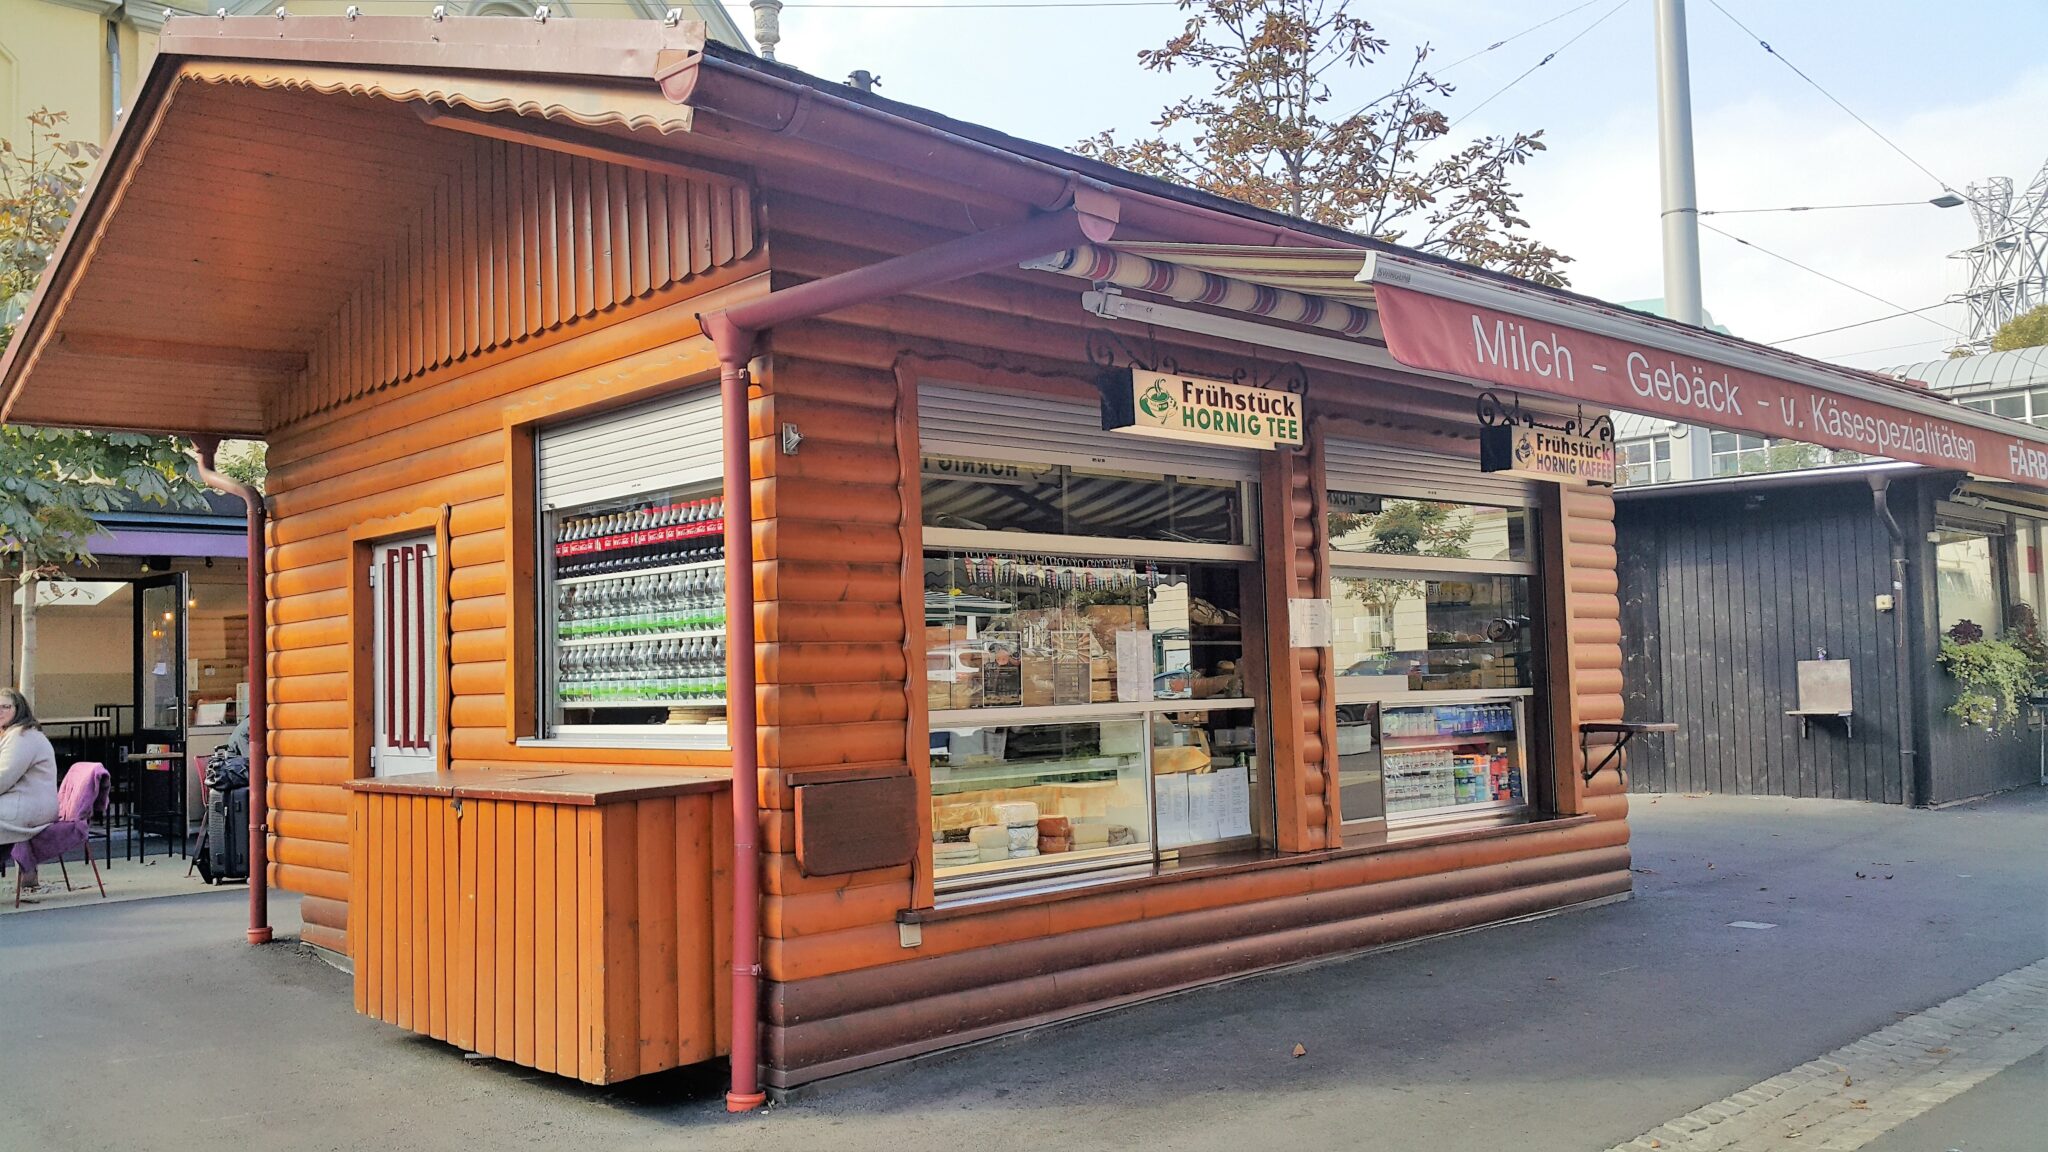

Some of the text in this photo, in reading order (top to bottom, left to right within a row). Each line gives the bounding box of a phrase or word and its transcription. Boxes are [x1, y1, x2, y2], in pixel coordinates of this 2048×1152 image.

[1181, 380, 1296, 417] Frühstück
[1471, 314, 1575, 382] Milch
[1592, 364, 1607, 372] -
[1626, 351, 1743, 416] Gebäck
[1780, 396, 1804, 429] u.
[1811, 393, 1977, 464] Käsespezialitäten
[1182, 405, 1298, 440] HORNIG TEE
[1536, 432, 1611, 461] Frühstück
[1536, 454, 1613, 479] HORNIG KAFFEE
